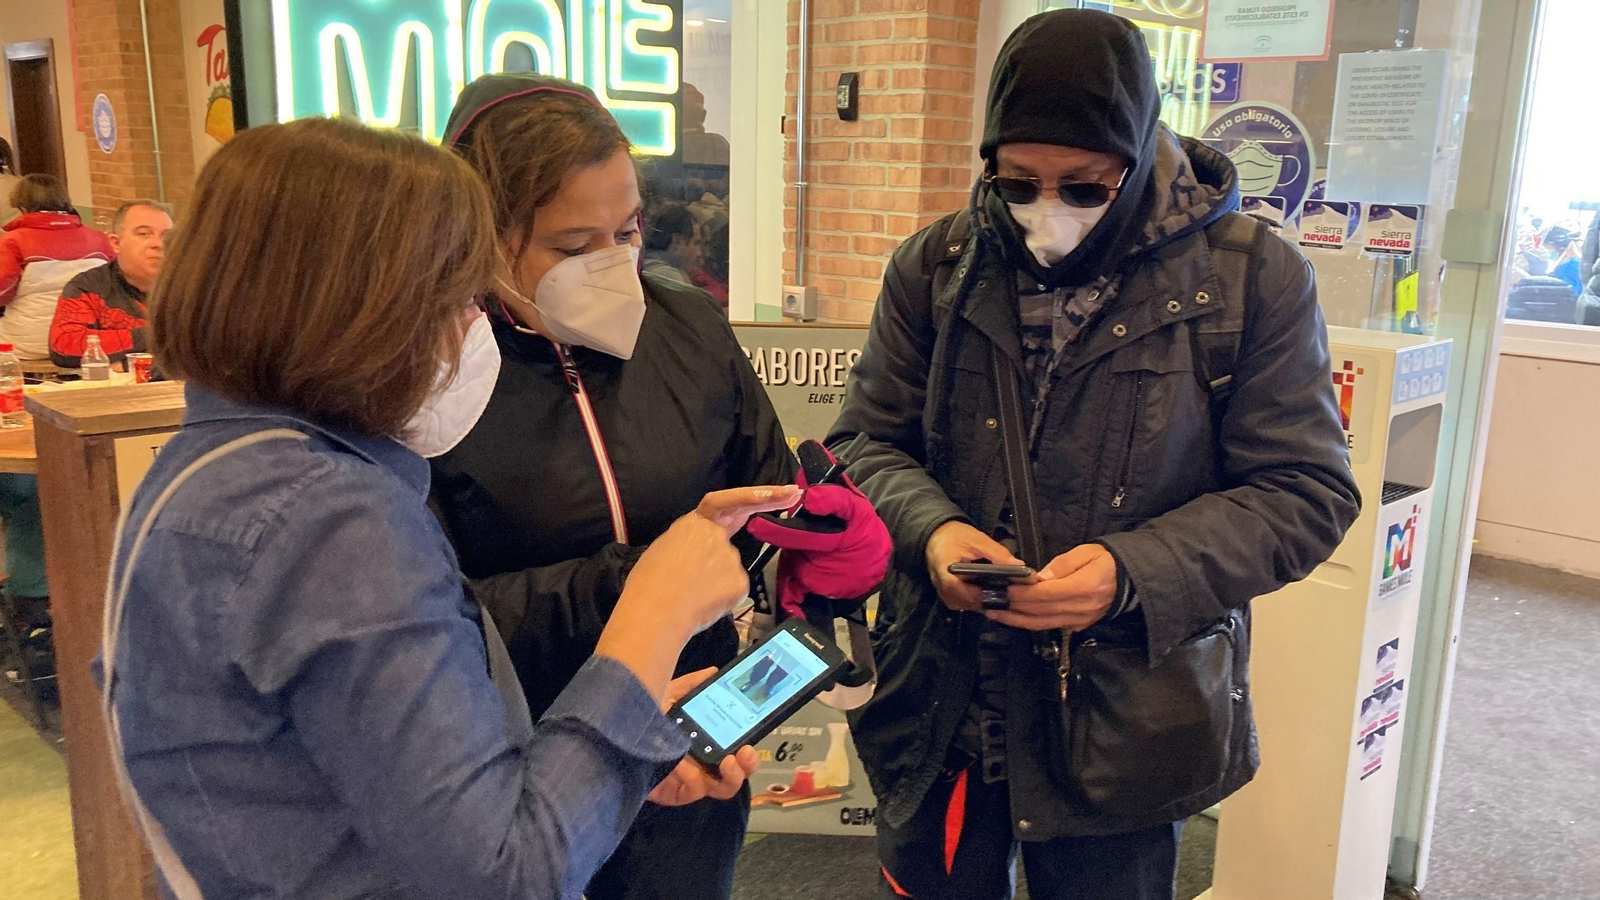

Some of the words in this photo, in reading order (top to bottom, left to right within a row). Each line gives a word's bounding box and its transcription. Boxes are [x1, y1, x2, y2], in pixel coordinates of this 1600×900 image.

[197, 24, 230, 87] Ta
[1212, 118, 1234, 138] uso
[1234, 108, 1293, 139] obligatorio
[1314, 224, 1343, 235] sierra
[1381, 229, 1412, 240] sierra
[1303, 233, 1342, 243] nevada
[1370, 237, 1411, 248] nevada
[808, 393, 836, 404] ELIGE
